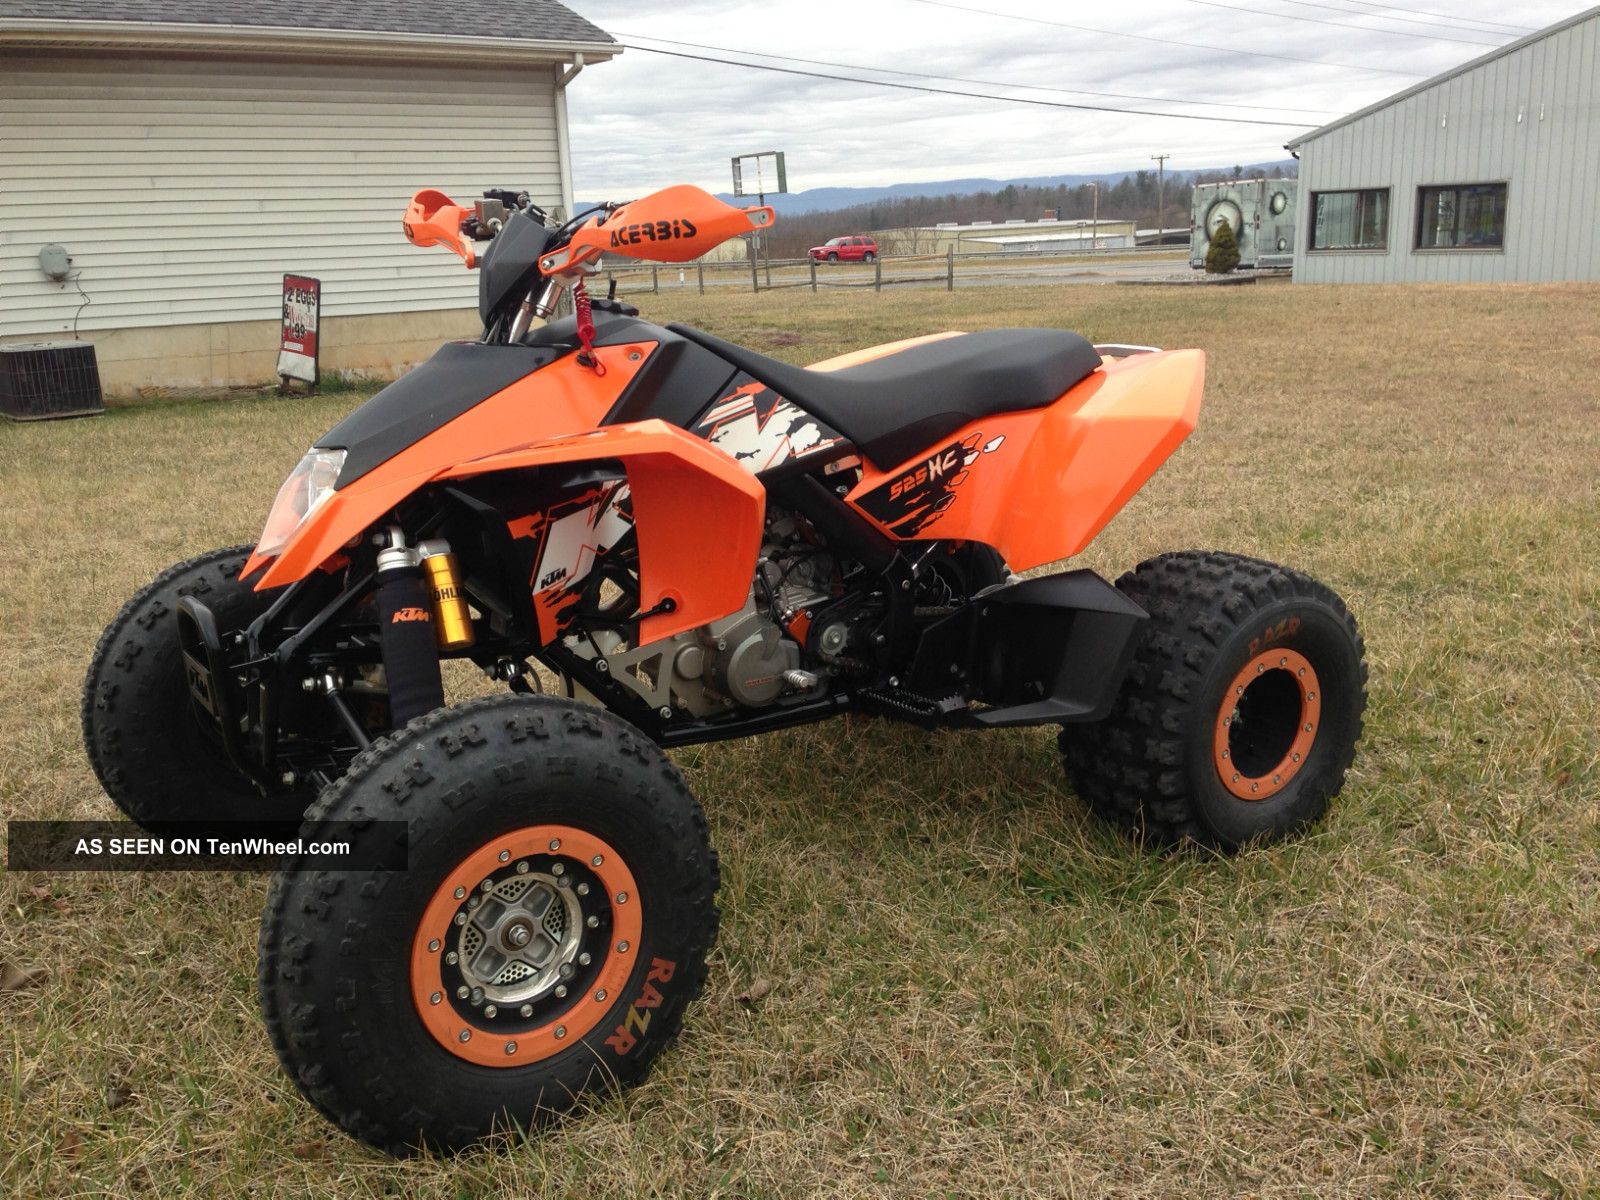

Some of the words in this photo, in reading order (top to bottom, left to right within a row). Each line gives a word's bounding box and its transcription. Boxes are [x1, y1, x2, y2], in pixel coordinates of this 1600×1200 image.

[610, 218, 698, 248] ACERBIS
[287, 287, 295, 302] 2
[295, 288, 317, 306] EGGS
[540, 567, 568, 590] KTM
[391, 607, 431, 624] KTM
[603, 957, 677, 1056] RAZR
